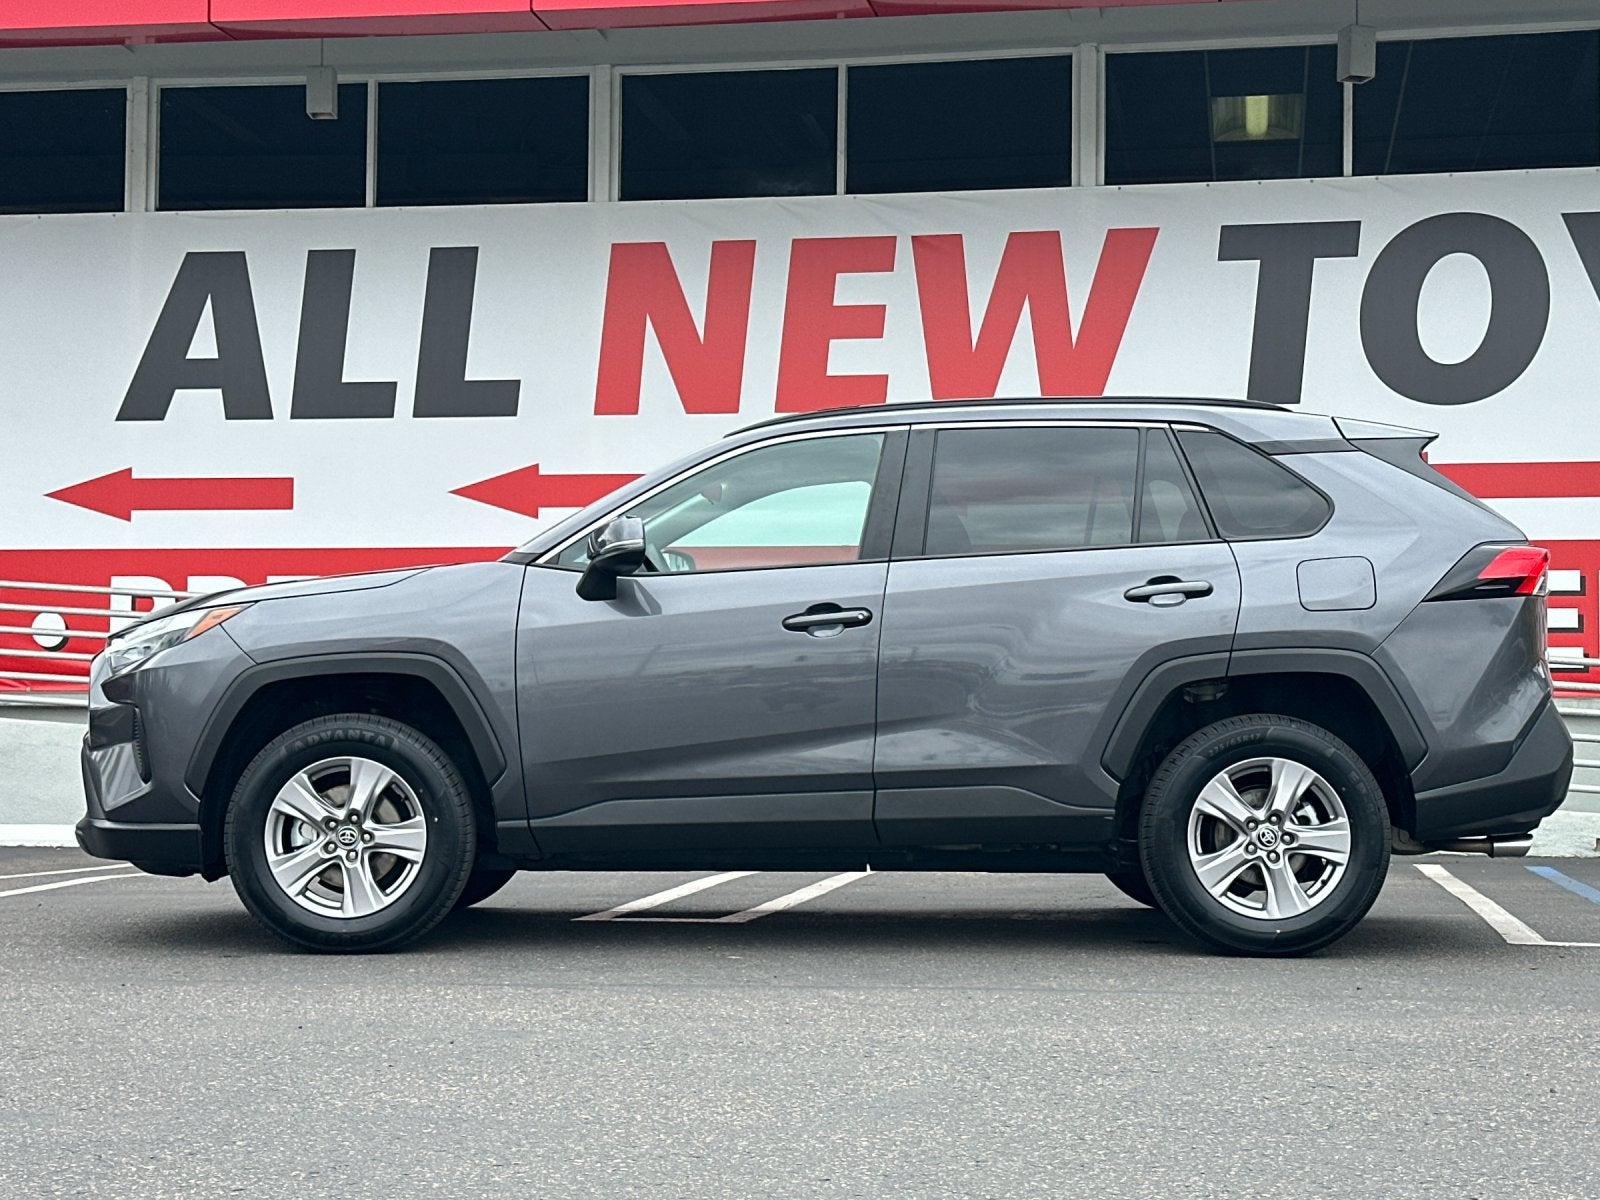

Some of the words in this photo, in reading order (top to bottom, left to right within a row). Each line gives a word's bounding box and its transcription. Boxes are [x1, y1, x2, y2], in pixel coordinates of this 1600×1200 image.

[115, 246, 521, 421] ALL
[594, 227, 1160, 415] NEW
[1217, 211, 1600, 406] TO
[294, 729, 386, 750] ADVANTA
